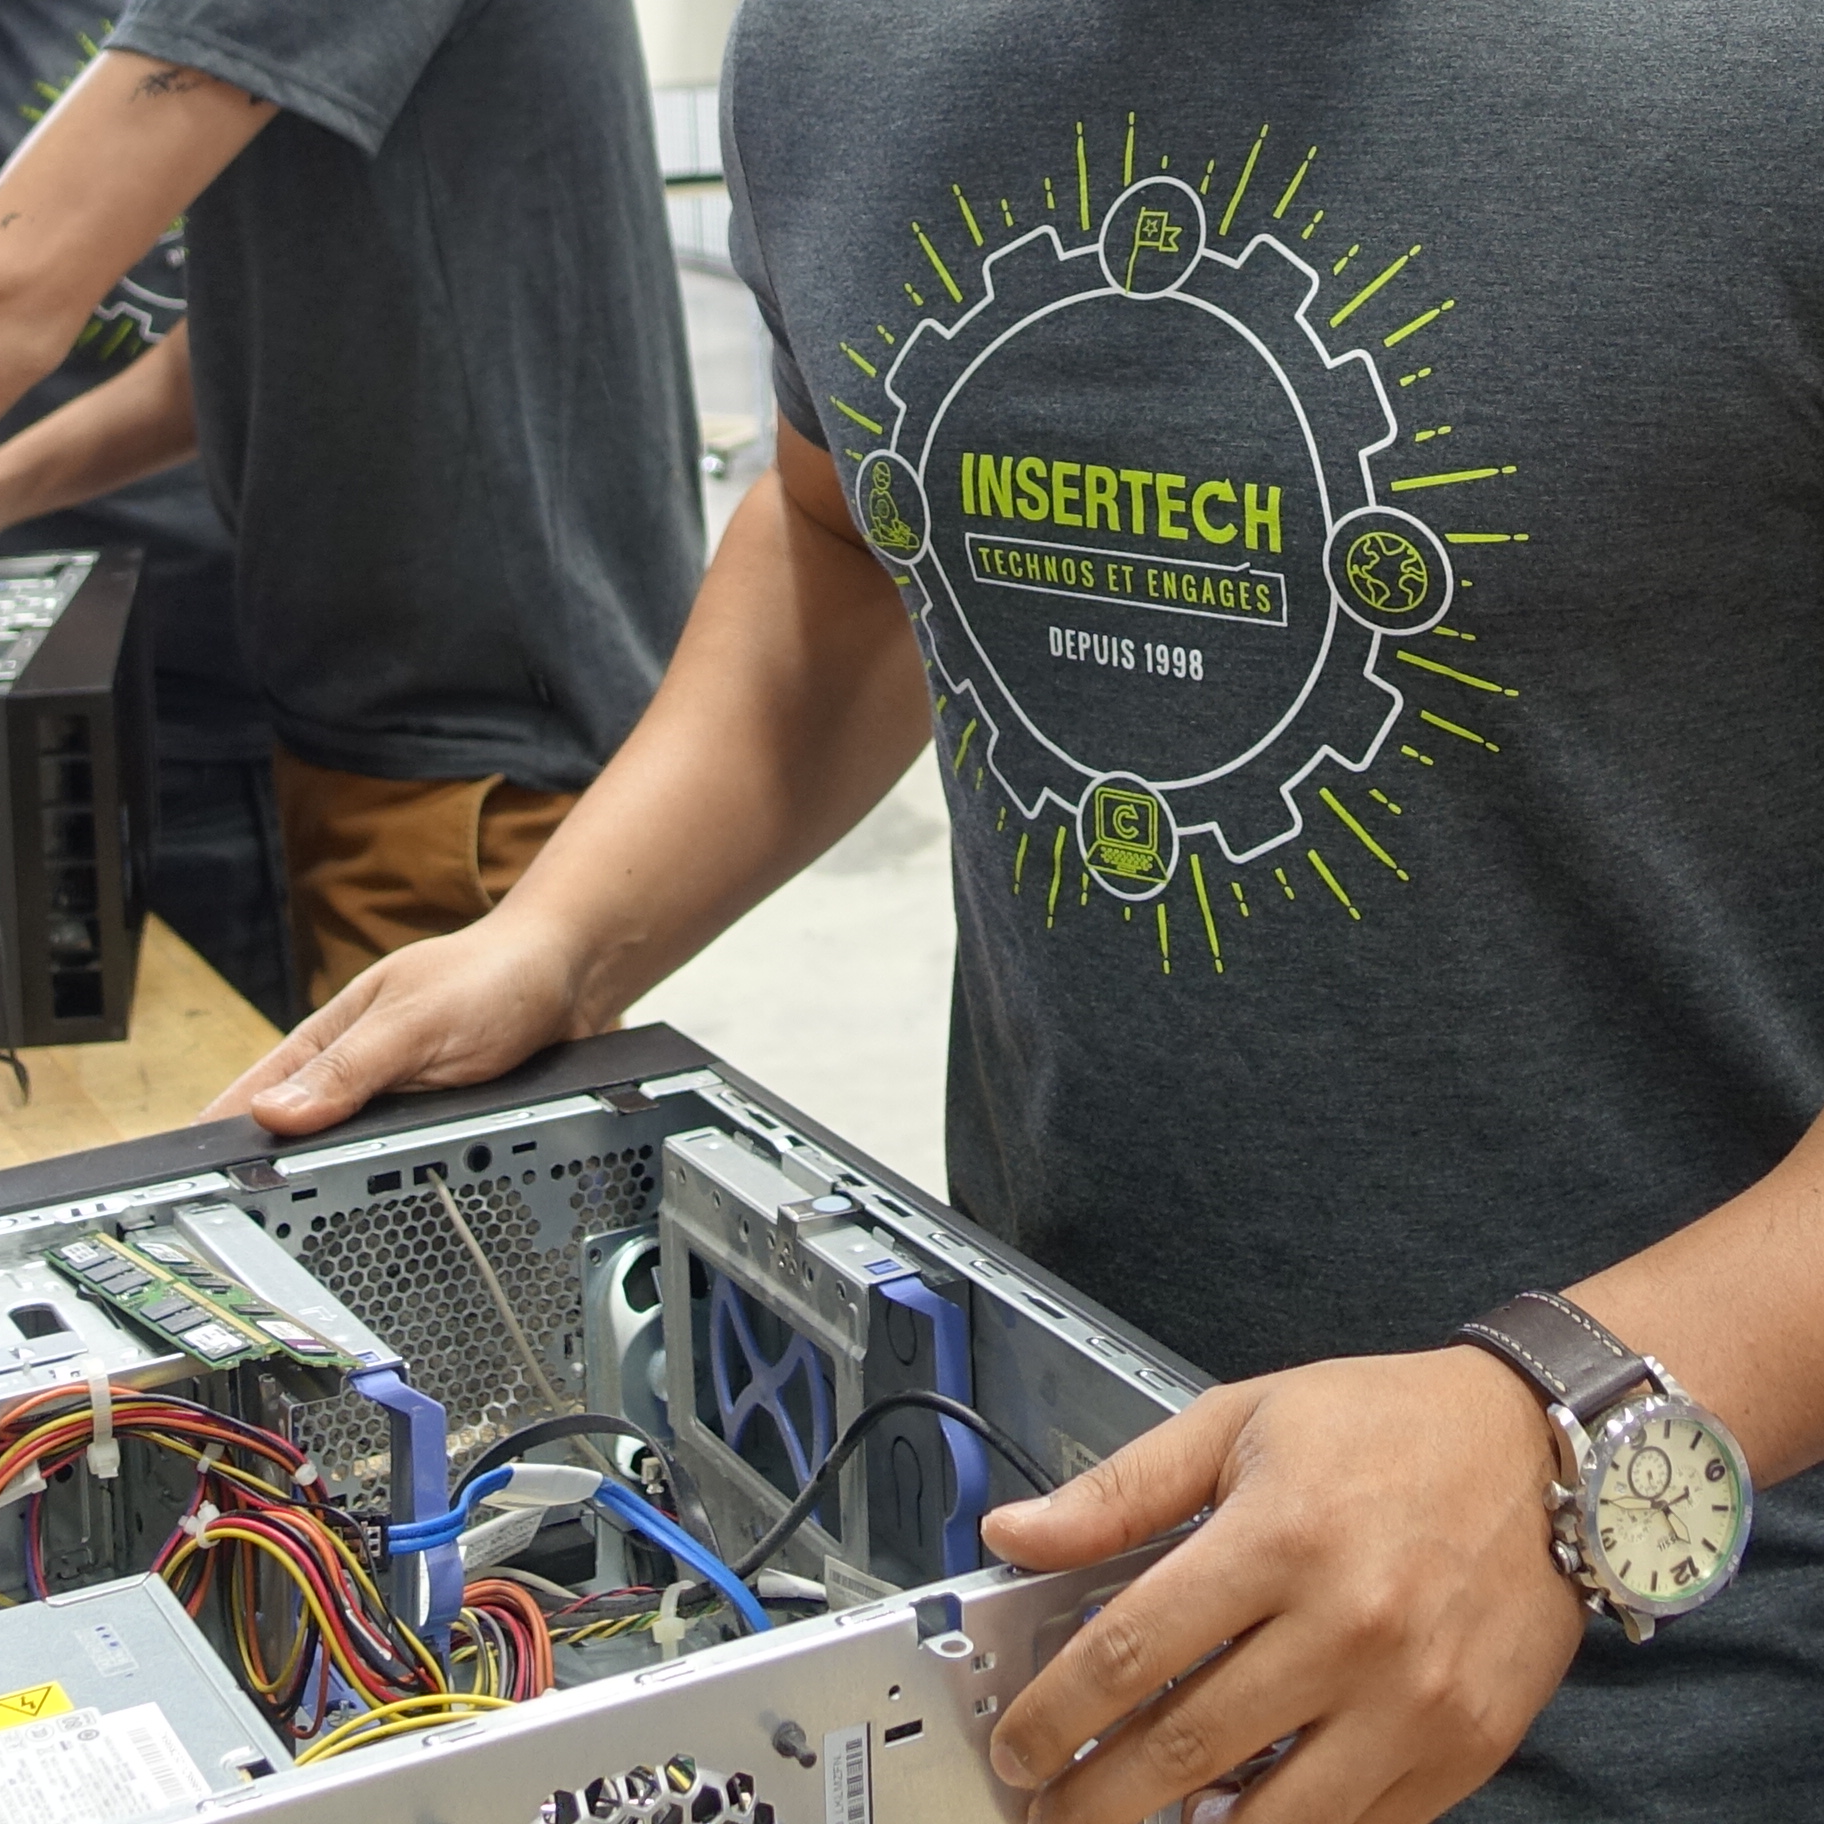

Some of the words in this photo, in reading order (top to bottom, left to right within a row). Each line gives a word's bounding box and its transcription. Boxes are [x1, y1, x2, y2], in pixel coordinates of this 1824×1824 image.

[961, 452, 1283, 553] INSERTECH
[978, 547, 1095, 588] TECHNOS
[1107, 563, 1133, 592] ET
[1049, 626, 1135, 670] DEPUIS
[1144, 642, 1204, 681] 1998
[1670, 1555, 1700, 1586] 12
